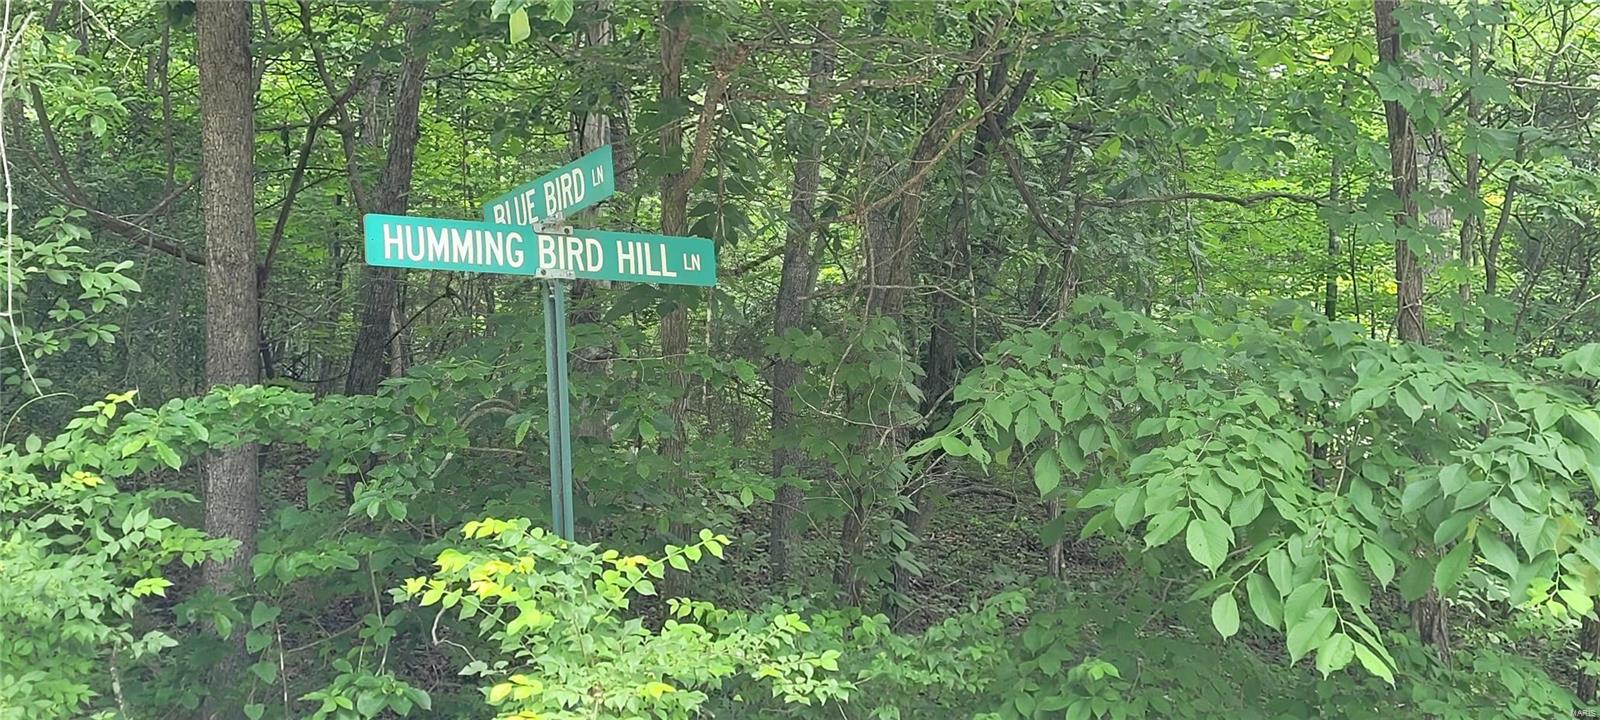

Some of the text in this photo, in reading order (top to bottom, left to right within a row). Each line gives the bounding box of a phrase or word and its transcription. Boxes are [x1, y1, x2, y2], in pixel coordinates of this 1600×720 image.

[493, 165, 604, 226] BLUE BIRD LN
[382, 223, 701, 278] HUMMING BIRD HILL LN
